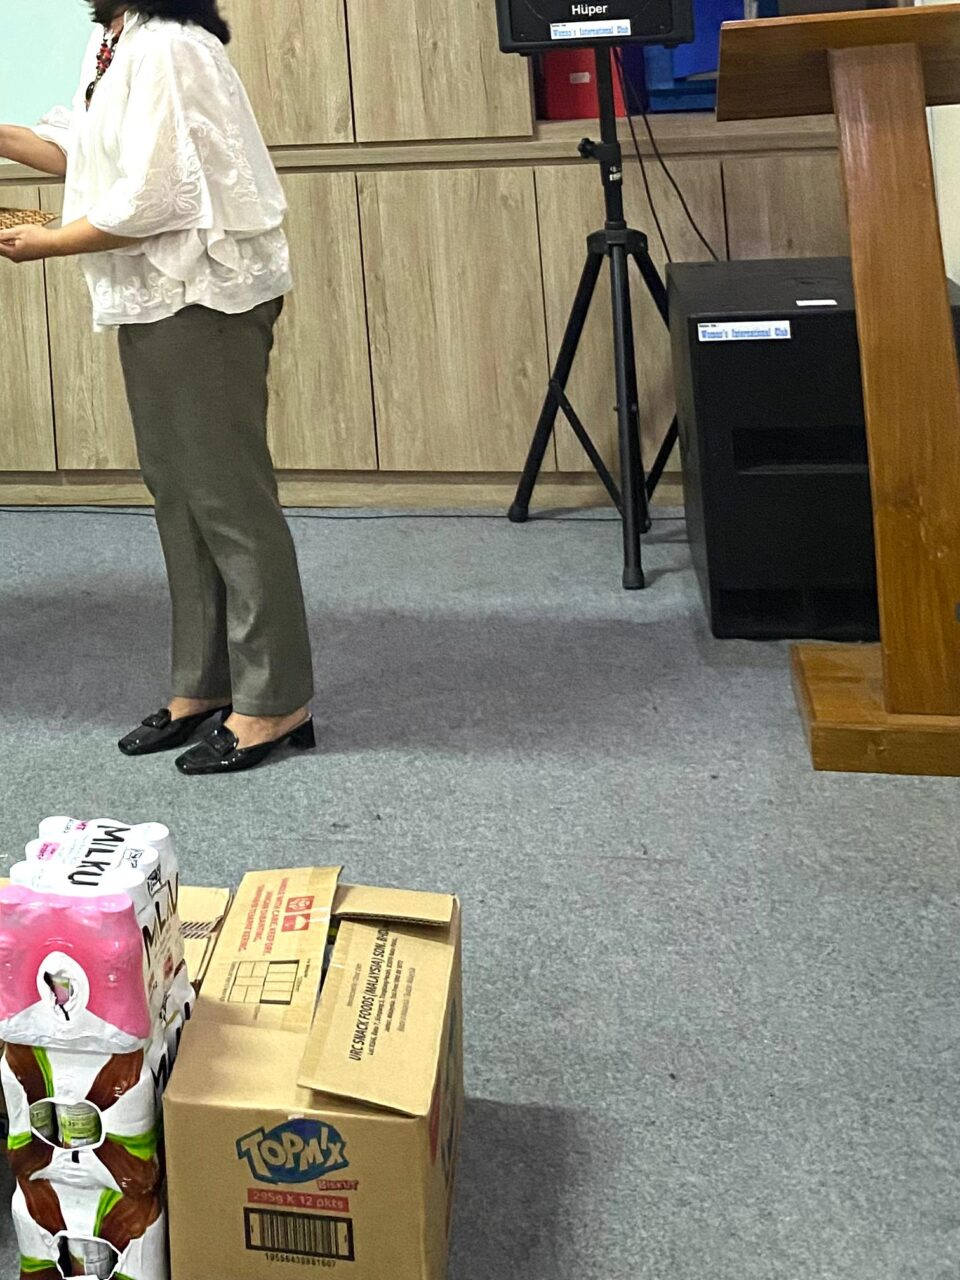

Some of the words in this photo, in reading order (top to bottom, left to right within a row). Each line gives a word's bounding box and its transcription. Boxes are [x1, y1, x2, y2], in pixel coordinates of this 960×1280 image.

[571, 4, 608, 17] Hüper
[68, 824, 131, 886] MILKU
[363, 957, 385, 998] (MALAYSIA)
[358, 995, 374, 1022] FOODS
[352, 1021, 368, 1045] SNACK
[348, 1043, 361, 1062] URC
[300, 1195, 313, 1207] 12
[316, 1196, 345, 1210] pkts
